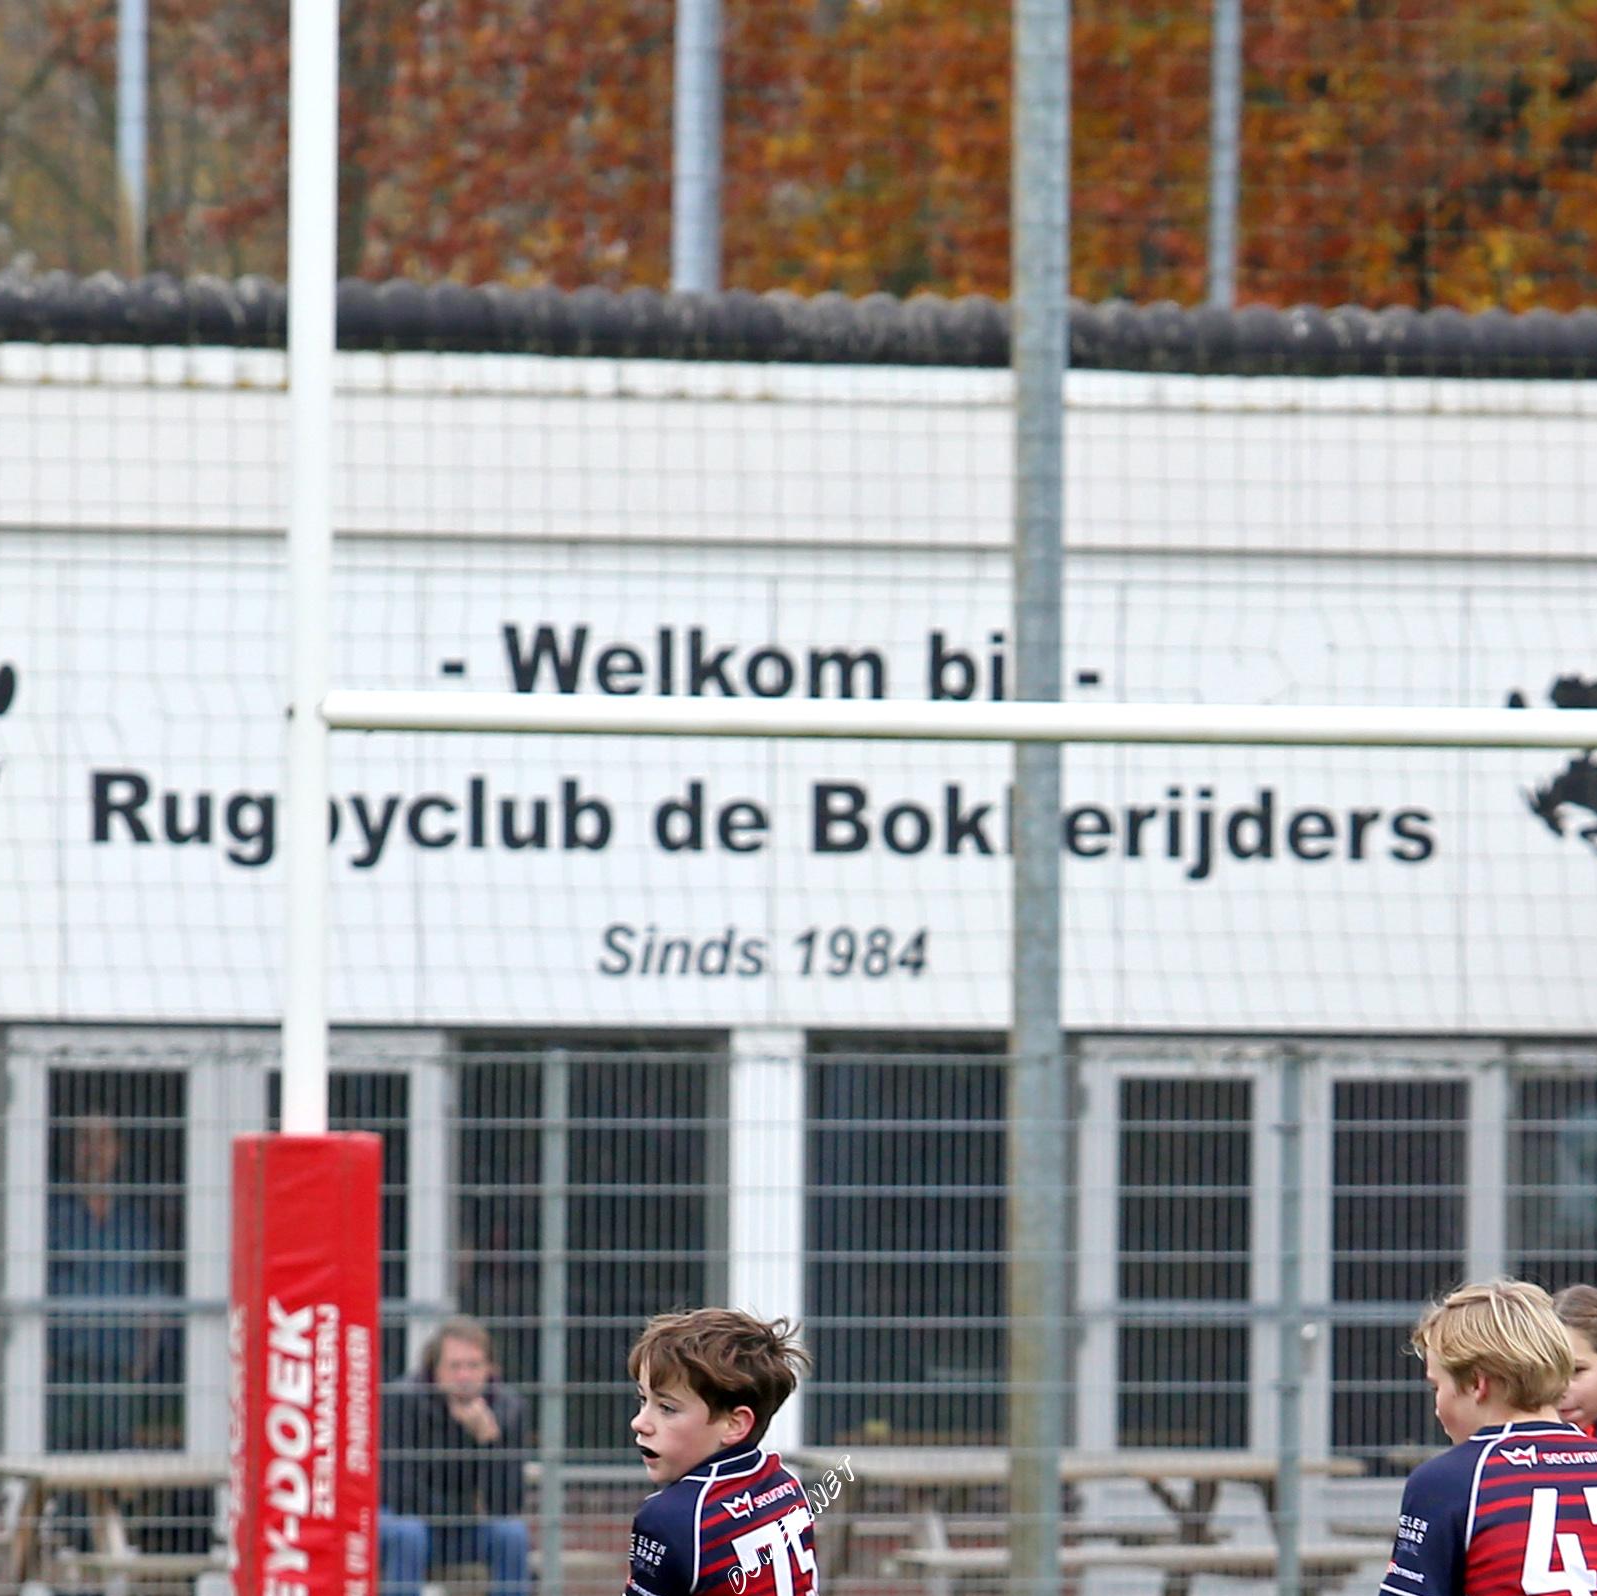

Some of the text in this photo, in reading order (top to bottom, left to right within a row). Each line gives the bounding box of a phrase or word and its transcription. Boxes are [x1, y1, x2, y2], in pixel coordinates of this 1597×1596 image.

[504, 623, 886, 702] Welkom
[928, 630, 1008, 704] bi
[654, 780, 768, 852] de
[812, 782, 1436, 880] Bokerijders
[599, 924, 928, 977] Sinds 1984
